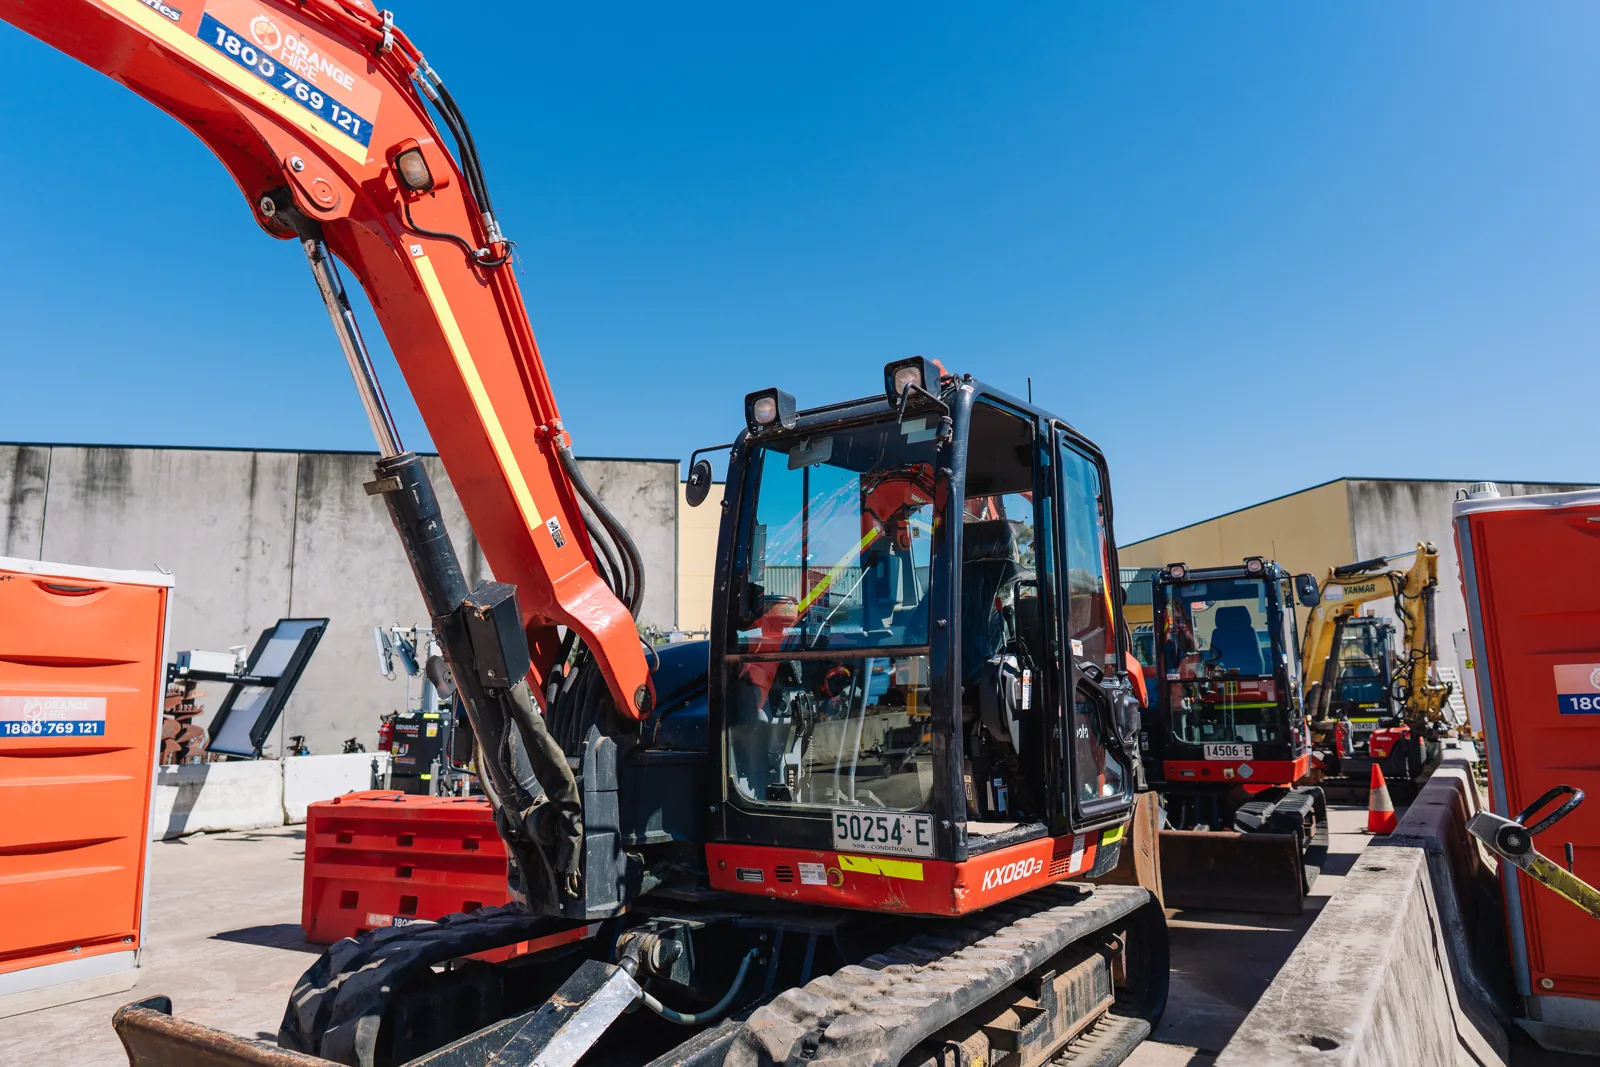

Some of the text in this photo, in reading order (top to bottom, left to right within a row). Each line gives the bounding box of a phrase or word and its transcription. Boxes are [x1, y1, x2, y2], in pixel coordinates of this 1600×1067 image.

[279, 47, 321, 83] HIRE
[284, 33, 355, 92] ORANGE
[215, 26, 361, 136] 1800 769 121
[1343, 583, 1376, 595] YANMAR
[44, 700, 89, 710] ORANGE
[44, 709, 67, 719] HIRE
[4, 722, 98, 735] 1800 769 121
[870, 844, 914, 853] CONDITIONAL
[981, 857, 1044, 892] KX080-3
